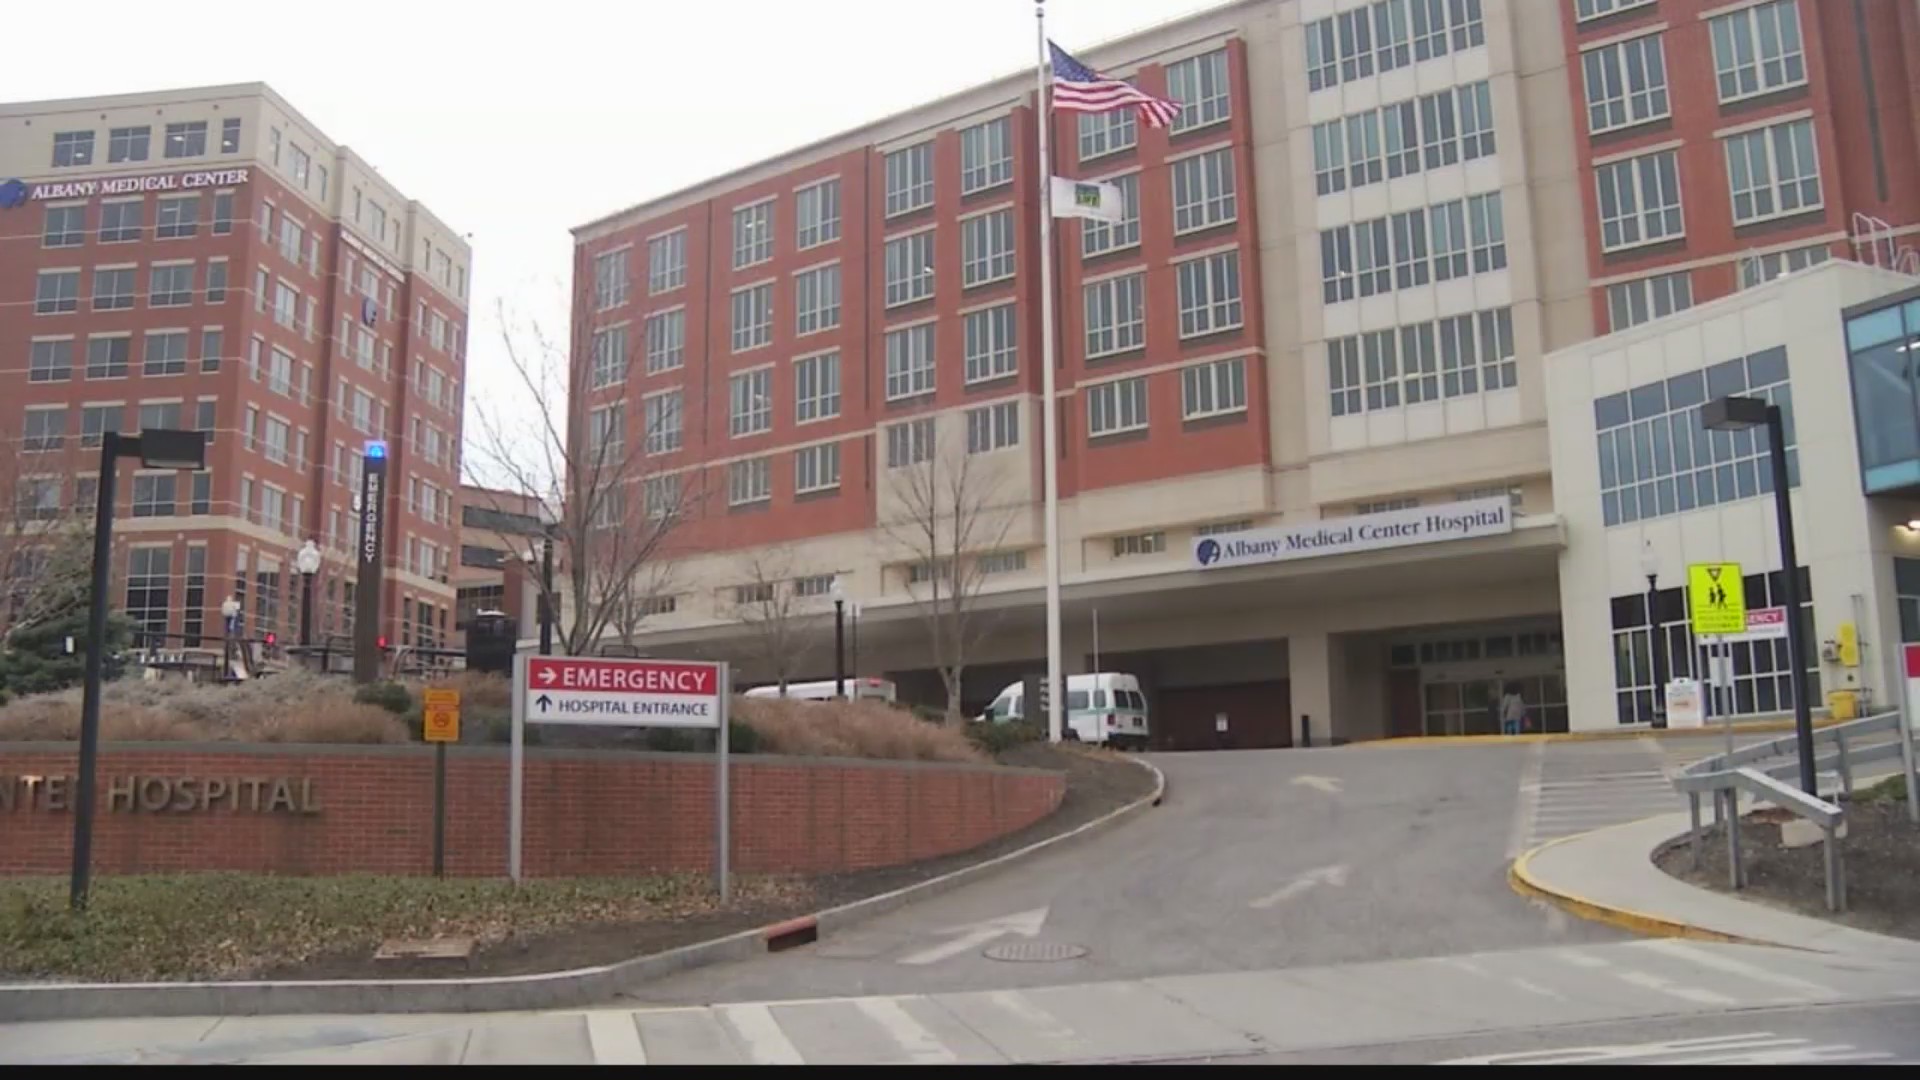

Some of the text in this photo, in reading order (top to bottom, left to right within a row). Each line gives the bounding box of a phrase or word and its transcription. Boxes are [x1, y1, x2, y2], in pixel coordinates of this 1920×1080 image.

[32, 168, 248, 199] ALBANY MEDICAL CENTER
[364, 473, 379, 563] EMERGENCY
[1223, 506, 1504, 557] Albany Medical Center Hospital
[563, 667, 706, 690] EMERGENCY
[558, 699, 708, 716] HOSPITAL ENTRANCE
[107, 774, 320, 813] HOSPITAL
